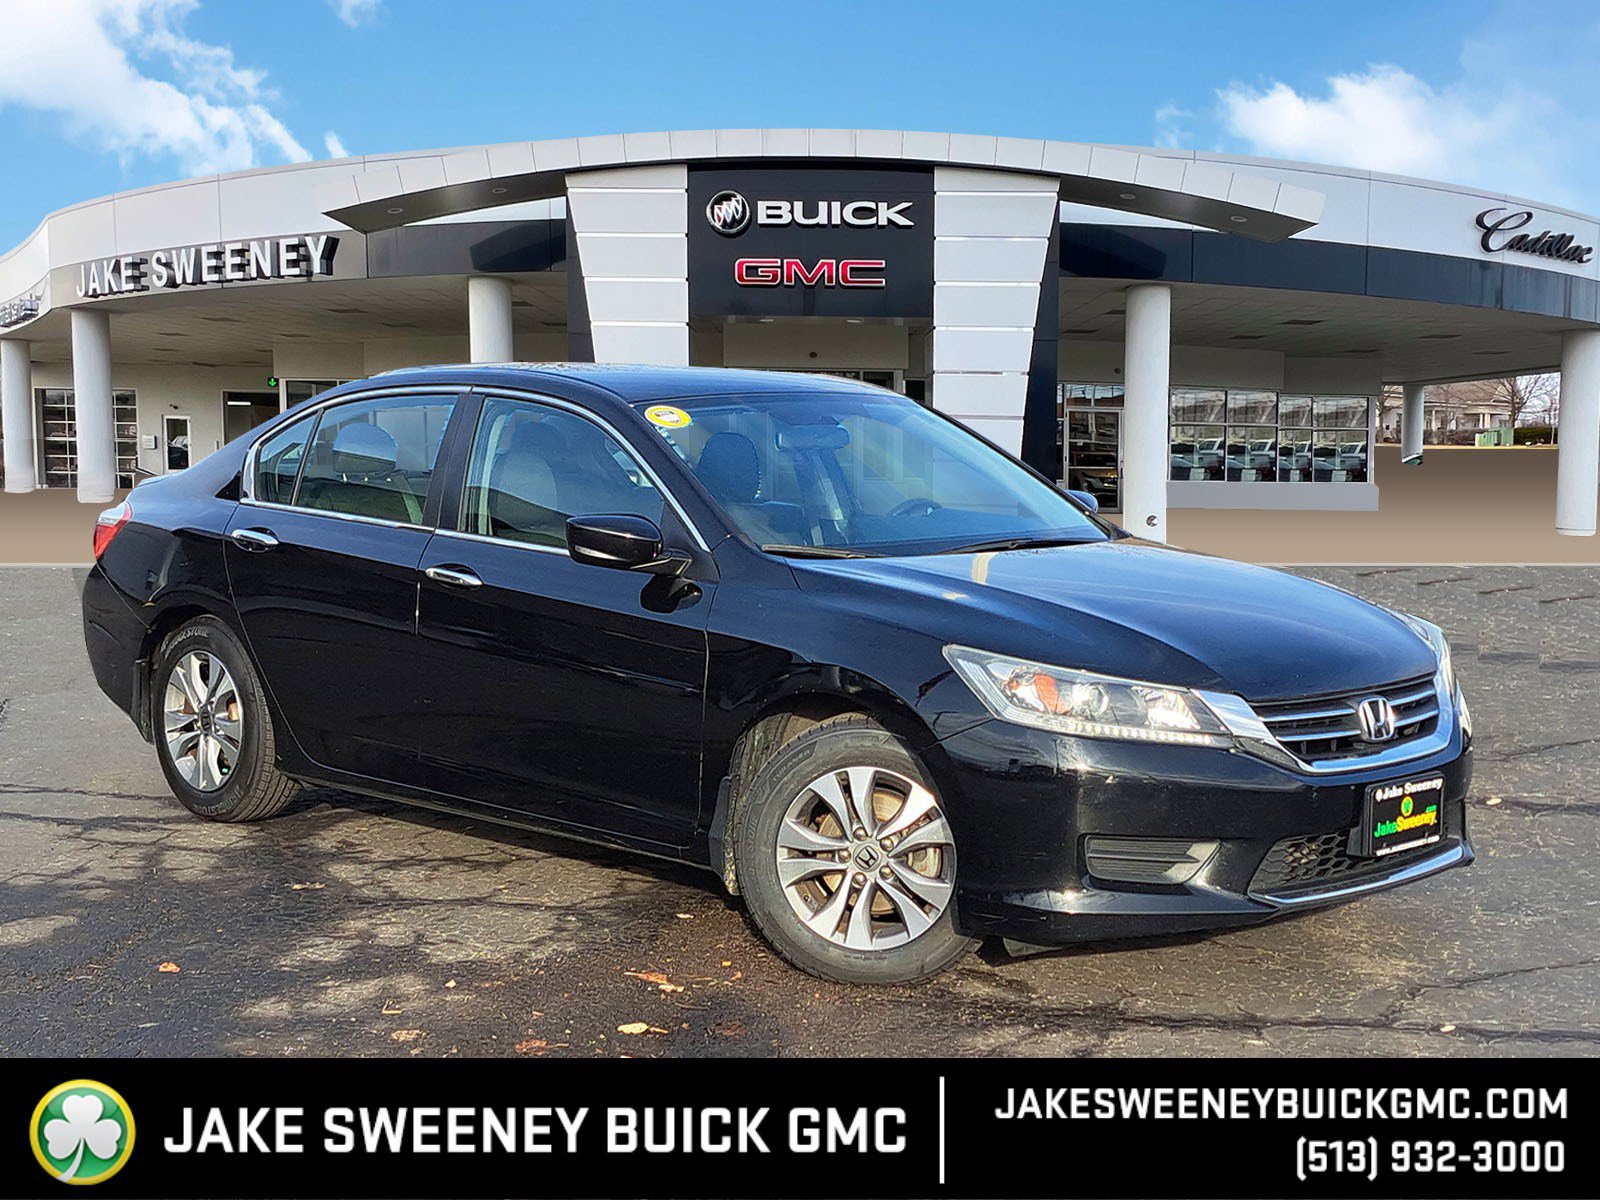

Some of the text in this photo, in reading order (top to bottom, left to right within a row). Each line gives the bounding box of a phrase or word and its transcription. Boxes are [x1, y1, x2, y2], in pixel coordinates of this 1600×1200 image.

[756, 200, 915, 227] BUICK
[1475, 207, 1593, 264] Cadillac
[76, 234, 333, 299] JAKE SWEENEY
[734, 257, 886, 287] GMC
[1382, 778, 1443, 800] Jake Sweeney
